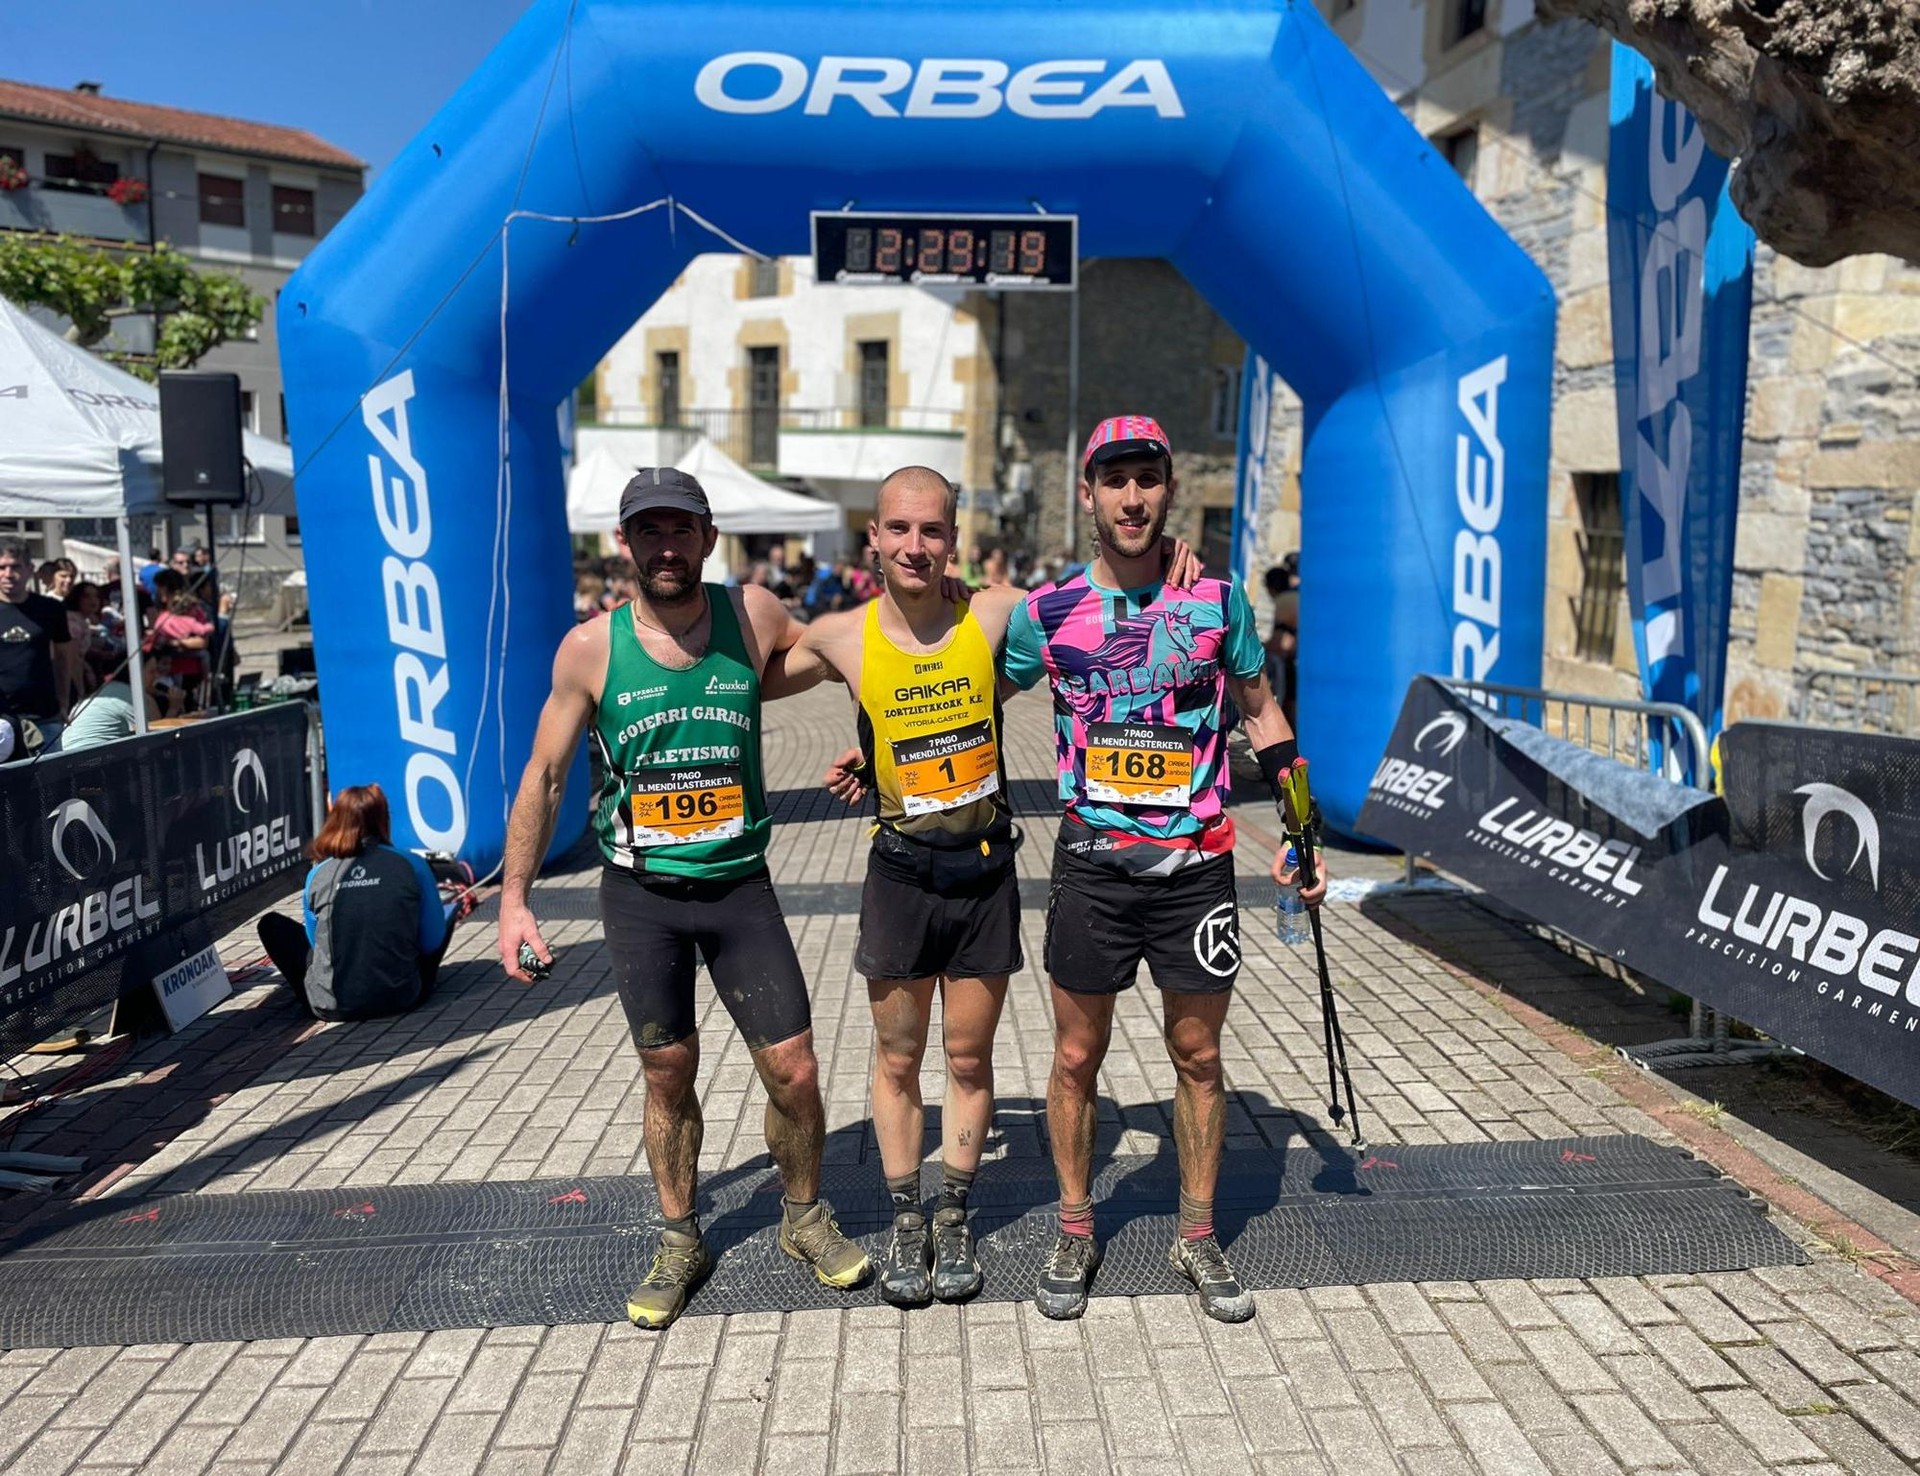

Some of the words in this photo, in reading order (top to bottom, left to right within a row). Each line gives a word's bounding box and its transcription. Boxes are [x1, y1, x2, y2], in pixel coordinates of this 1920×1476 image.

[694, 51, 1186, 119] ORBEA
[361, 369, 467, 858] ORBEA
[894, 677, 971, 702] GAIKAR
[884, 698, 963, 718] ZORTZIETAKOAK
[904, 711, 969, 728] VITORIA-GASTEIZ
[618, 707, 688, 745] GOIERRI
[691, 706, 751, 732] GARAIA
[1124, 729, 1129, 737] 7
[1130, 729, 1154, 738] PAGO
[909, 749, 936, 761] MENDI
[936, 735, 986, 755] LASTERKETA
[928, 739, 934, 747] 7
[935, 734, 958, 747] PAGO
[1101, 737, 1128, 746] MENDI
[1129, 738, 1184, 750] LASTERKETA
[671, 773, 676, 781] 7
[677, 771, 701, 780] PAGO
[938, 757, 956, 783] 1
[1106, 750, 1165, 779] 168
[647, 781, 676, 792] MENDI
[678, 776, 733, 789] LASTERKETA
[655, 791, 718, 820] 196
[196, 815, 300, 890] LURBEL
[1466, 809, 1541, 869] PRECISION
[1549, 867, 1627, 908] GARMENT
[1479, 796, 1643, 896] LURBEL
[0, 874, 160, 987] LURBEL
[0, 957, 85, 1004] RECISION
[97, 920, 161, 959] GARMENT
[1685, 927, 1801, 983] PRECISION
[162, 949, 216, 997] KRONOAK
